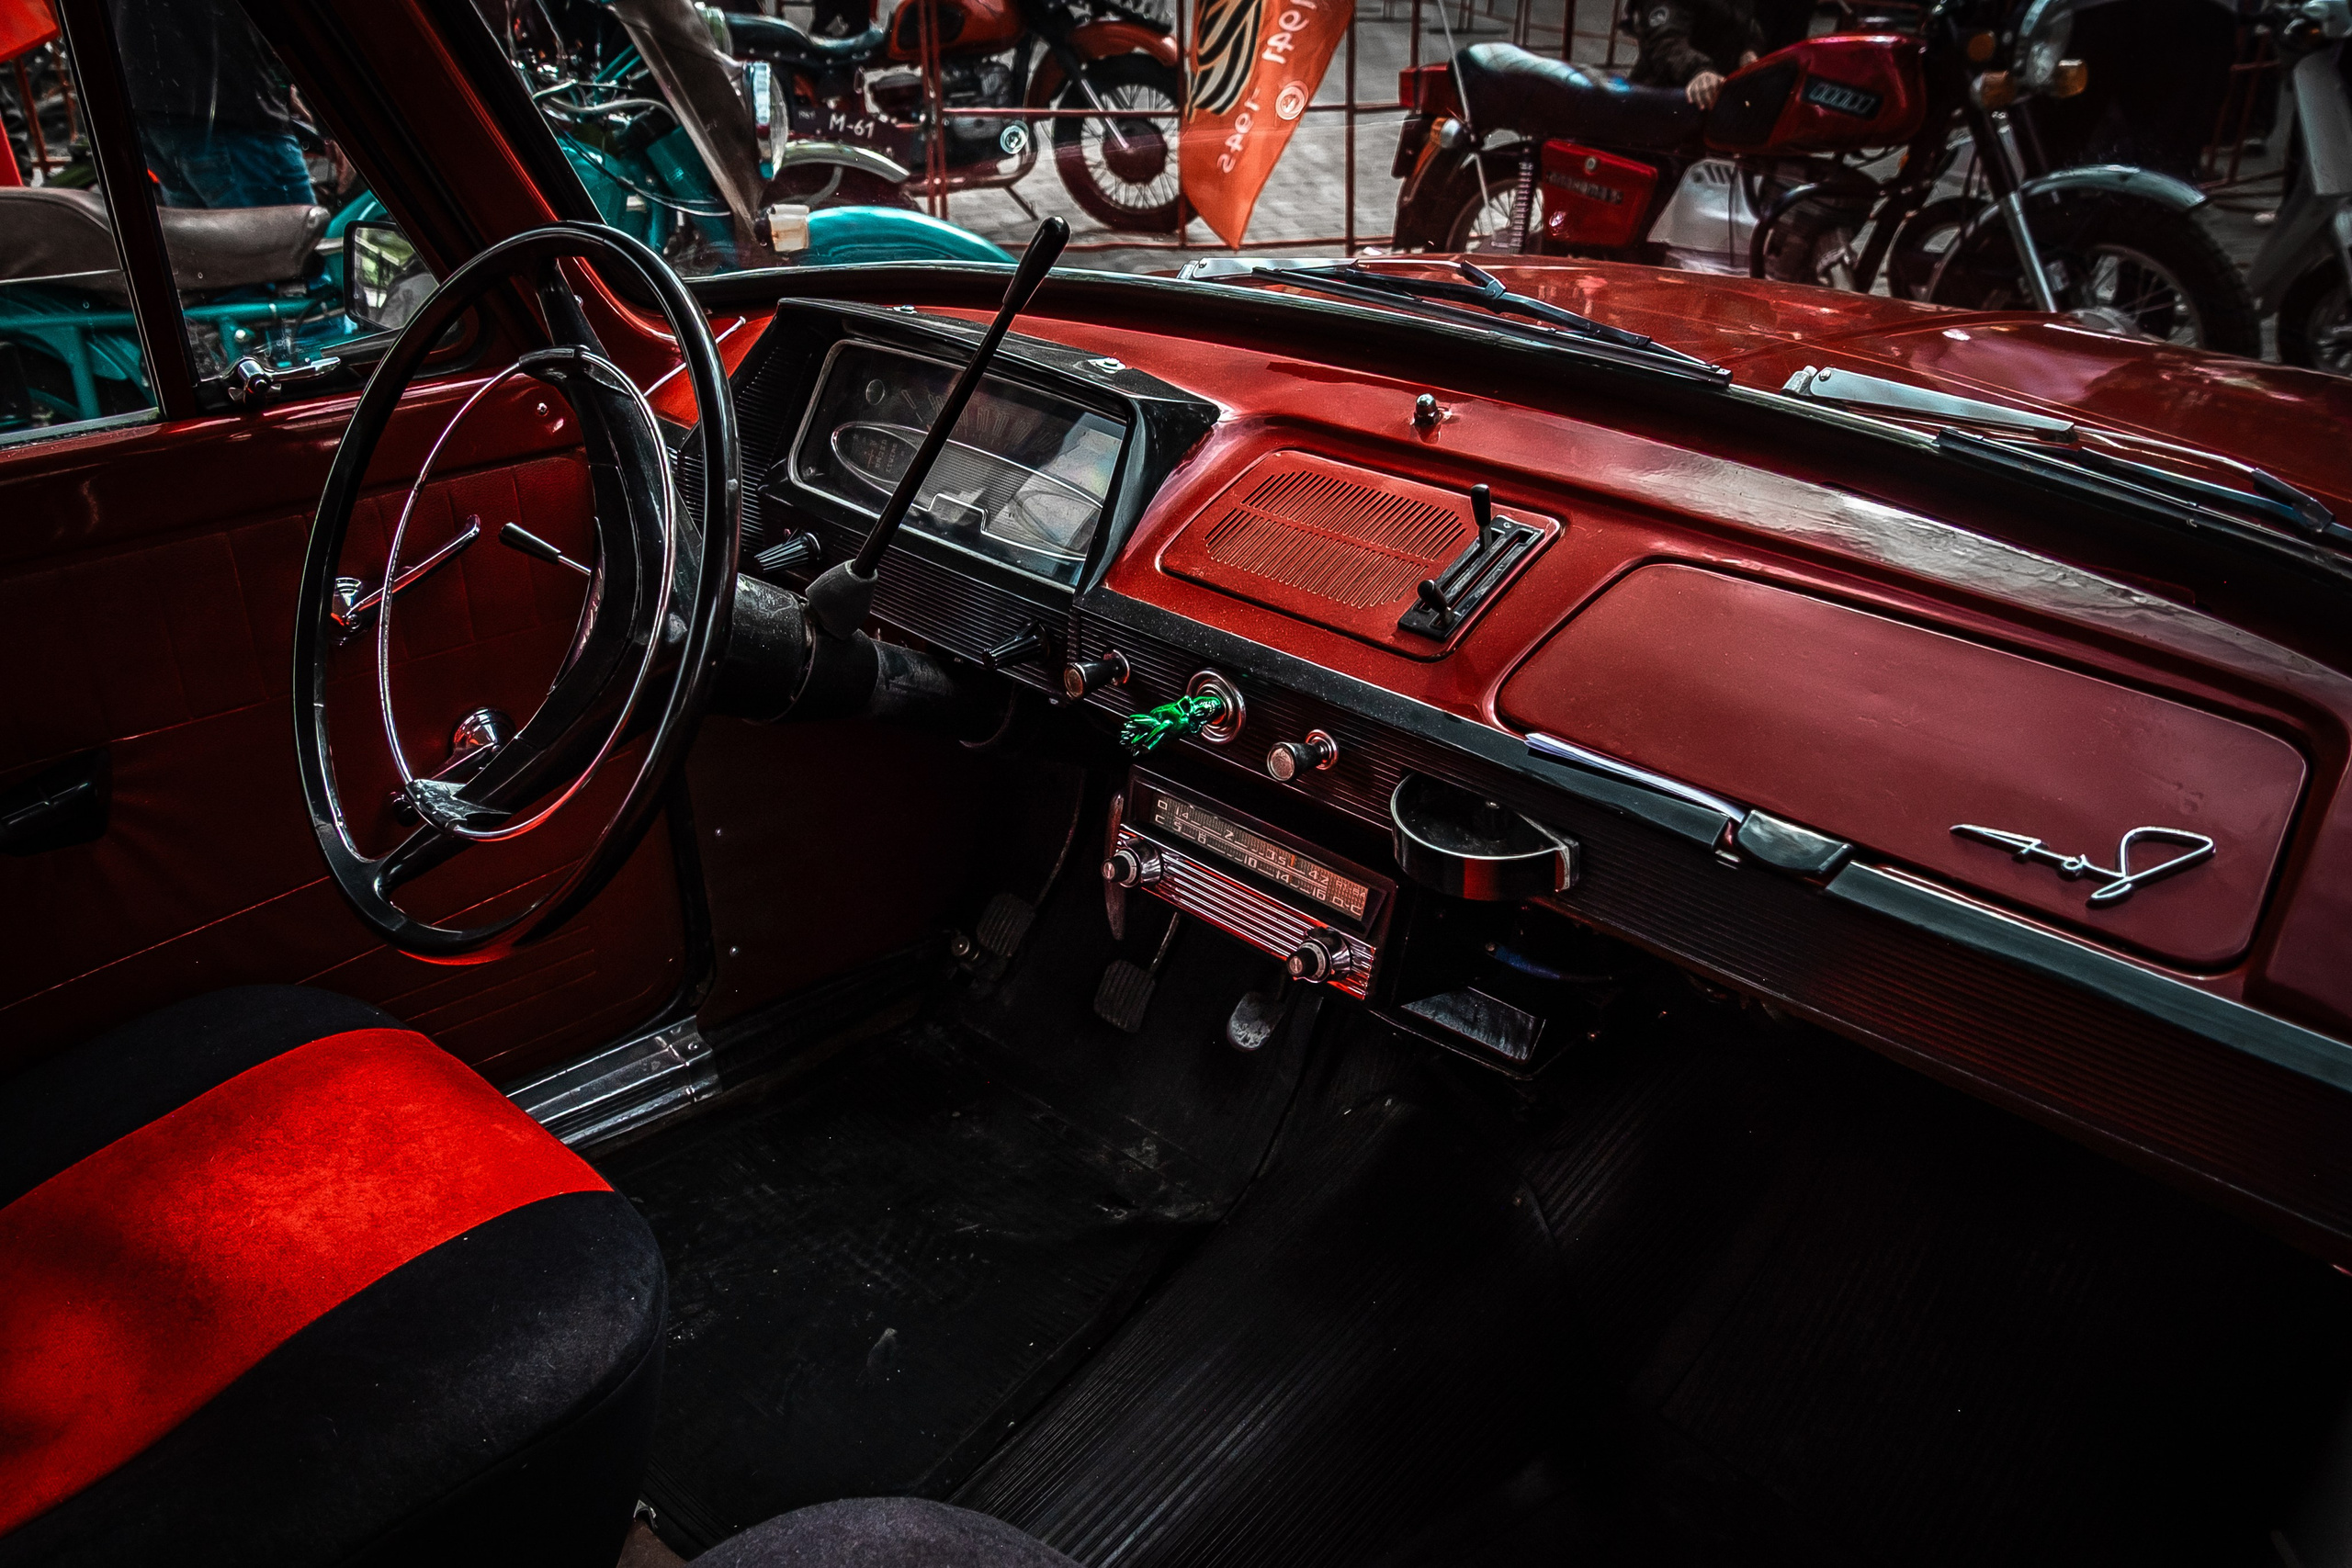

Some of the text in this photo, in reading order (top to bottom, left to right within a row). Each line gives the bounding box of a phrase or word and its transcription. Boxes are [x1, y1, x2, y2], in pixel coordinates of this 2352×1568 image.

[1224, 829, 1234, 841] 2
[1244, 854, 1258, 869] 10
[1275, 870, 1289, 884] 14
[1312, 886, 1327, 901] 16
